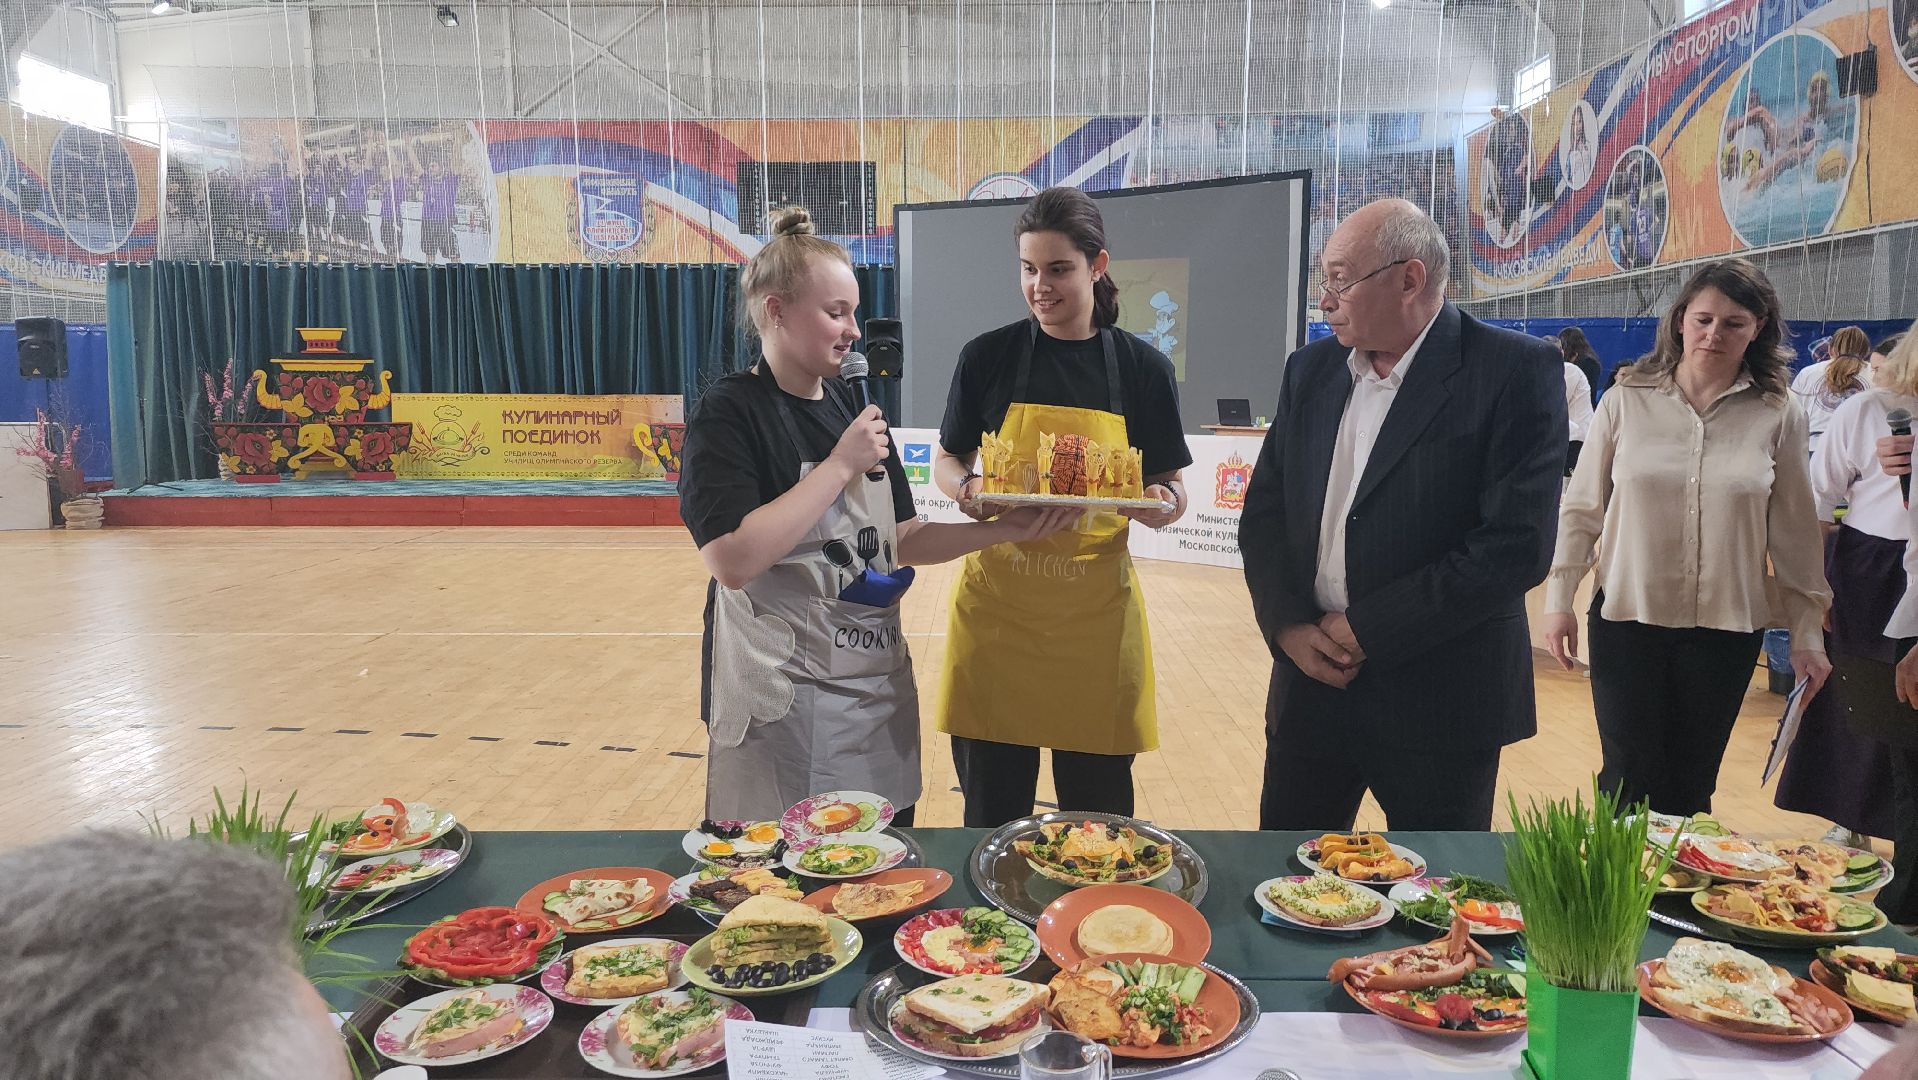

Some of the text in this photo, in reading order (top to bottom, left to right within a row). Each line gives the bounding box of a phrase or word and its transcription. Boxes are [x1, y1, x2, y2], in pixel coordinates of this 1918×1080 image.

[502, 409, 622, 426] КУЛИНАРНЫЙ
[502, 429, 602, 445] ПОЕДИНОК
[527, 450, 557, 458] КОМАНД
[928, 499, 955, 510] округ
[1196, 513, 1240, 526] Министе
[1215, 531, 1240, 541] куль
[1179, 539, 1241, 554] Московской
